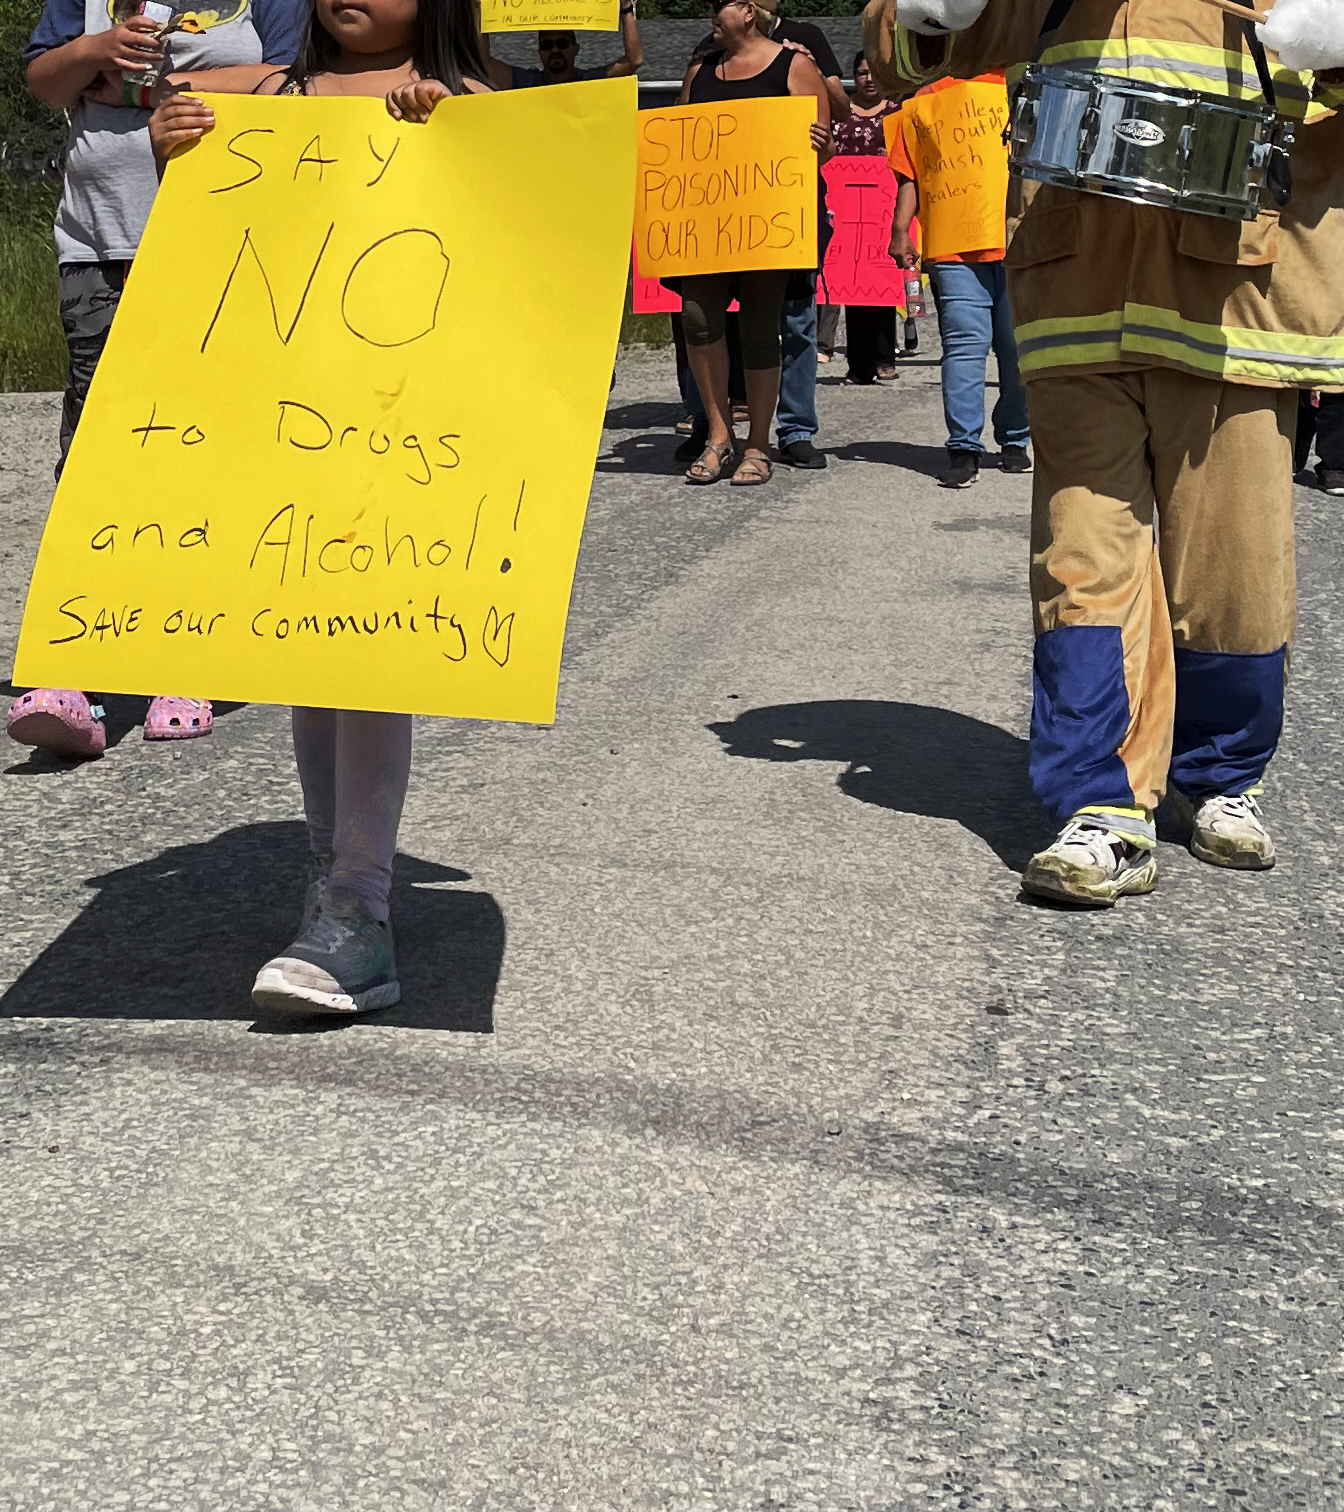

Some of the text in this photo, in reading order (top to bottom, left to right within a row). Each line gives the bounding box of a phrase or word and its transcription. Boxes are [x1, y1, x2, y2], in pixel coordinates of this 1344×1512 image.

[502, 15, 513, 24] IN
[957, 97, 1008, 120] illega
[208, 128, 401, 194] SAY
[642, 113, 738, 167] STOP
[644, 156, 805, 212] POISONING
[646, 206, 806, 262] OUR KIDS!
[200, 221, 451, 354] NO
[132, 400, 462, 486] to Drugs
[90, 479, 526, 587] and Alcohol!
[163, 607, 227, 637] our
